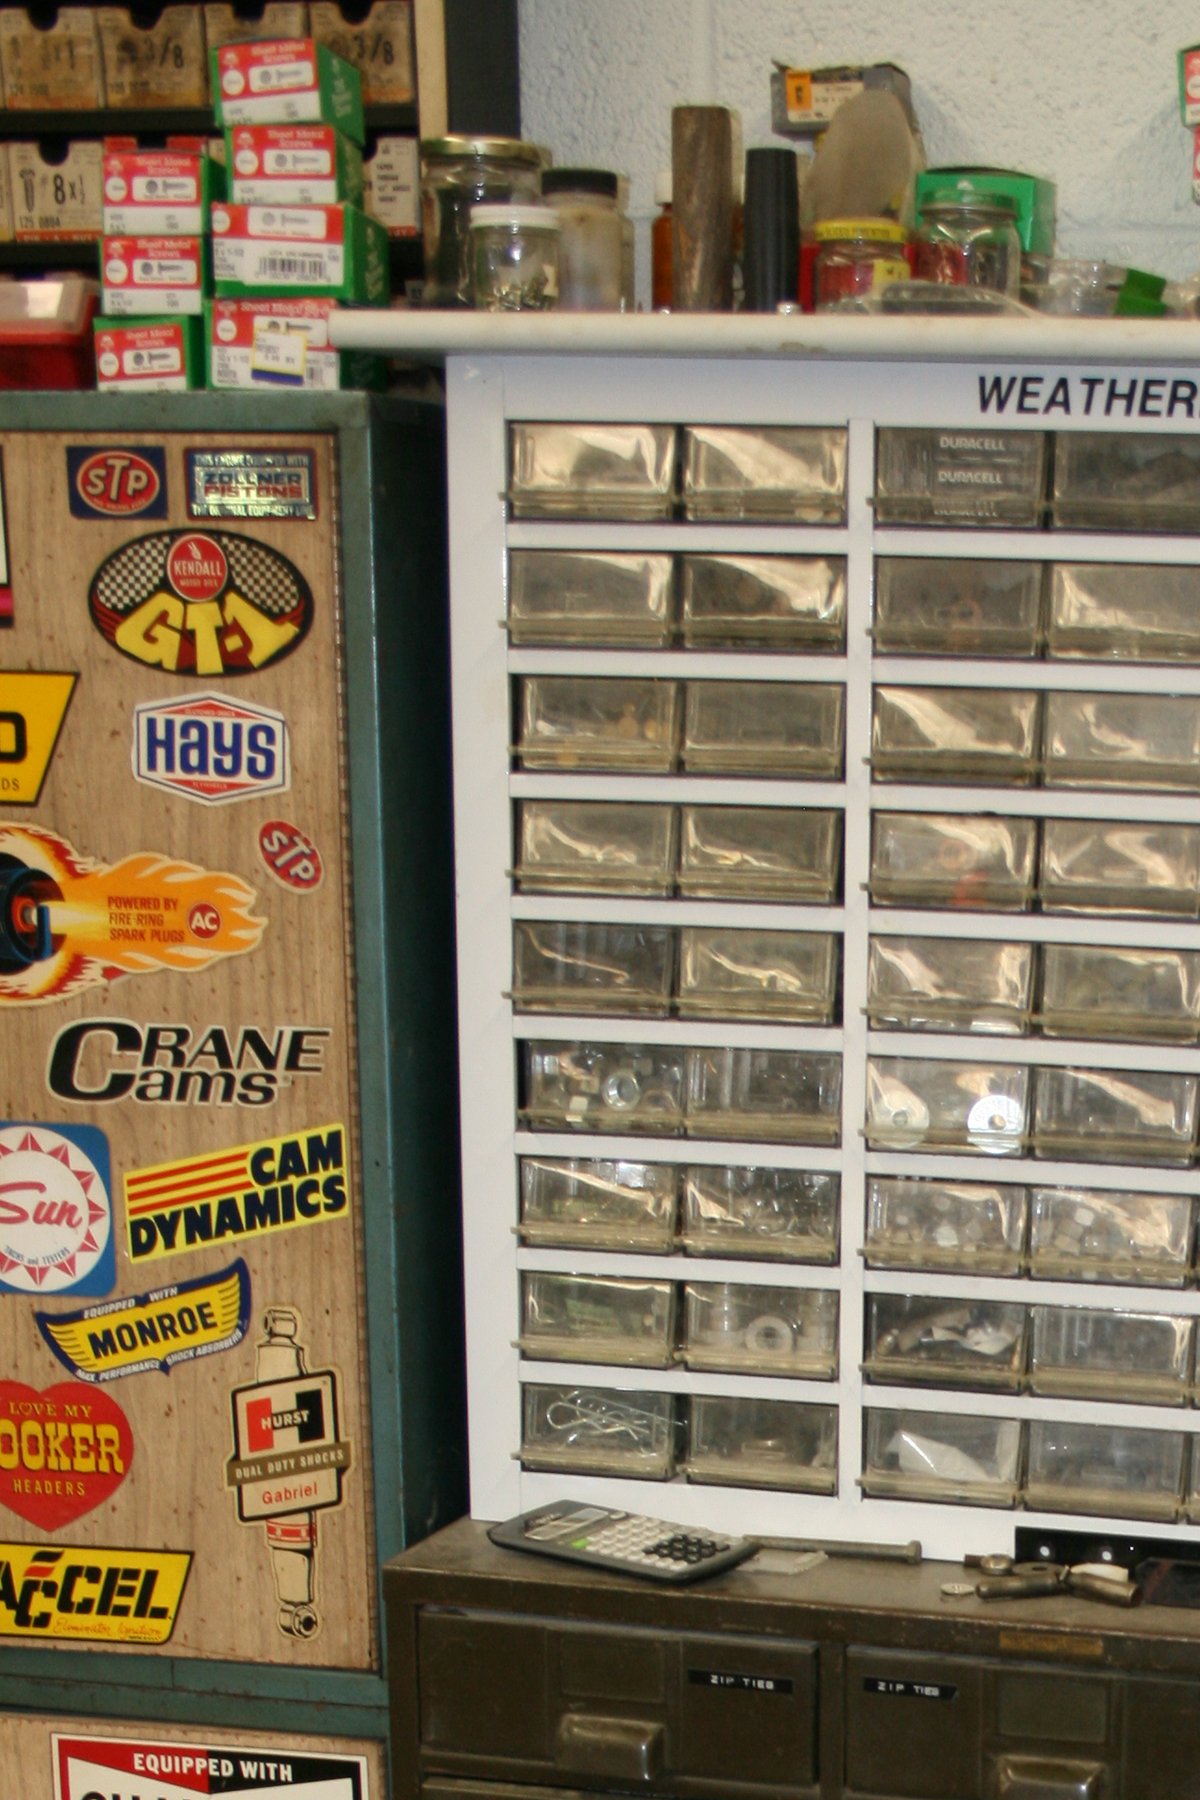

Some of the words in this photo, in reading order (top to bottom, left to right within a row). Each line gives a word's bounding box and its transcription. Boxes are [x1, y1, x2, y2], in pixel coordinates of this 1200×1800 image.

[53, 173, 66, 205] 8
[940, 436, 1005, 451] DURACELL
[86, 458, 148, 501] STP
[204, 472, 303, 485] ZOLLNER
[938, 470, 1003, 484] DURACELL
[204, 483, 304, 498] PISTONS
[174, 559, 222, 577] KENDALL
[263, 830, 315, 881] STP
[108, 896, 160, 911] POWERED
[163, 897, 178, 912] BY
[191, 912, 218, 930] AC
[110, 928, 146, 942] SPARK
[150, 929, 185, 943] PLUGS
[49, 1021, 330, 1101] CRANE
[250, 1130, 343, 1187] CAM
[129, 1174, 347, 1258] DYNAMICS
[83, 1298, 136, 1320] EQUIPPED
[149, 1286, 178, 1303] WITH
[87, 1302, 218, 1360] MONROE
[99, 1360, 161, 1382] PERFORMANCE
[165, 1349, 195, 1367] SHOCK
[64, 1404, 92, 1418] MY
[261, 1409, 310, 1431] HURST
[235, 1464, 263, 1480] DUAL
[267, 1457, 297, 1474] DUTY
[299, 1448, 345, 1468] SHOCKS
[13, 1478, 86, 1497] HEADERS
[262, 1482, 318, 1505] Gabriel
[710, 1674, 734, 1685] ZIP
[743, 1677, 774, 1690] TIES
[877, 1680, 904, 1692] ZIP
[913, 1684, 940, 1697] TIES
[133, 1752, 234, 1778] EQUIPPED
[239, 1760, 293, 1782] WITH
